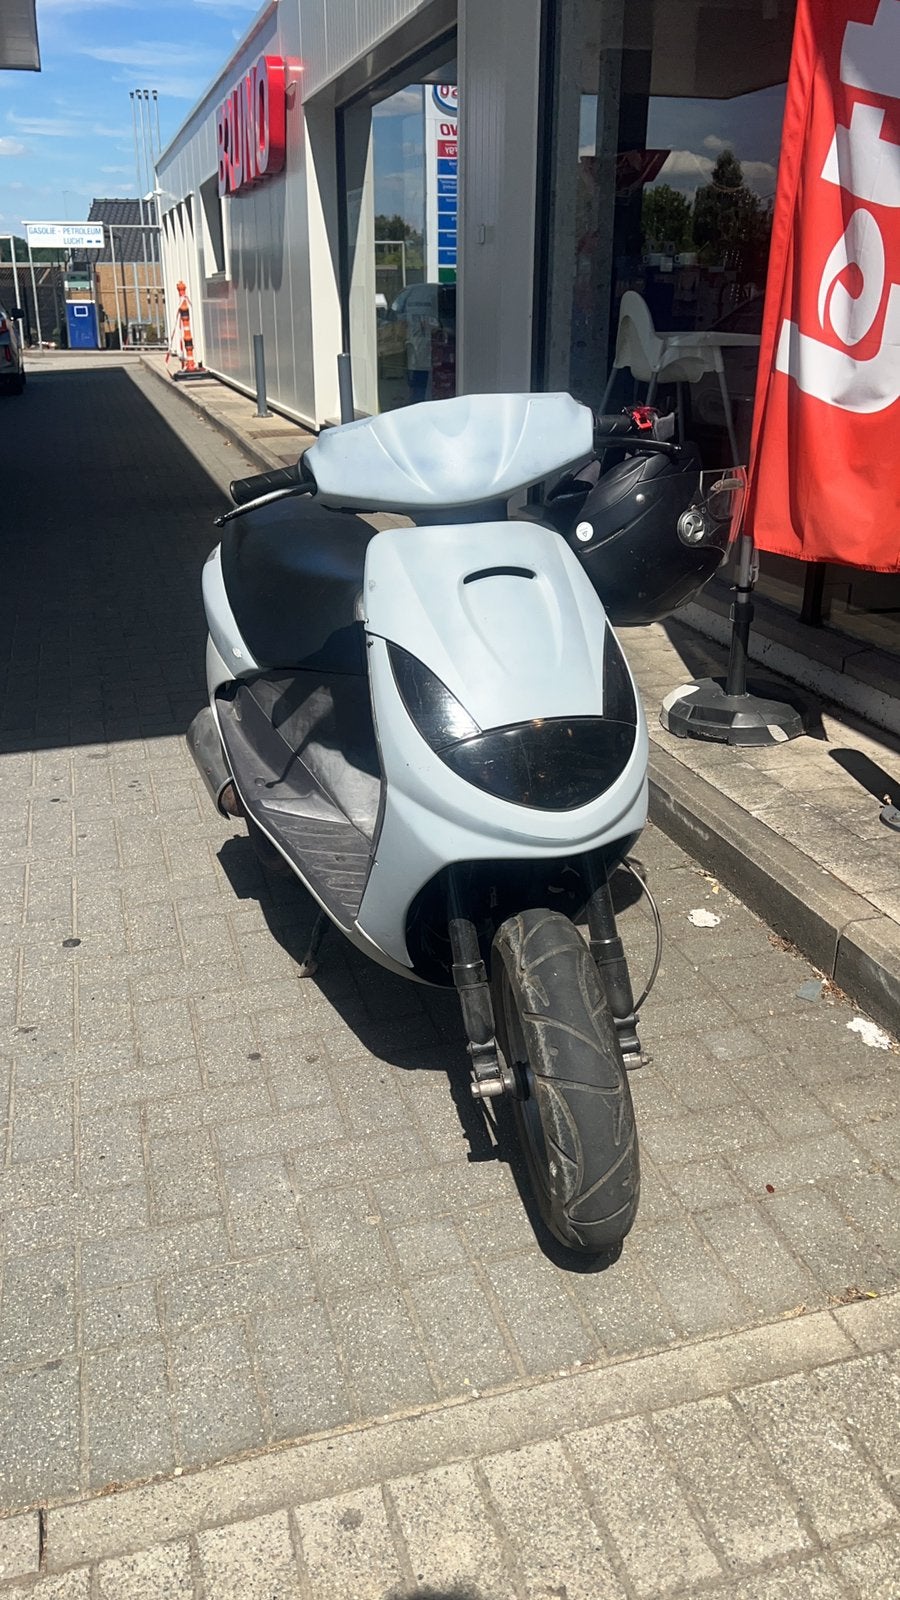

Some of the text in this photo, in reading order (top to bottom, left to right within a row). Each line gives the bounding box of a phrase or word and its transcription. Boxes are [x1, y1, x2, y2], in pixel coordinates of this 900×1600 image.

[215, 55, 284, 197] BRUNO
[29, 226, 56, 235] GASOLIE
[62, 227, 101, 235] PETROLEUM
[63, 237, 84, 245] LUCHT
